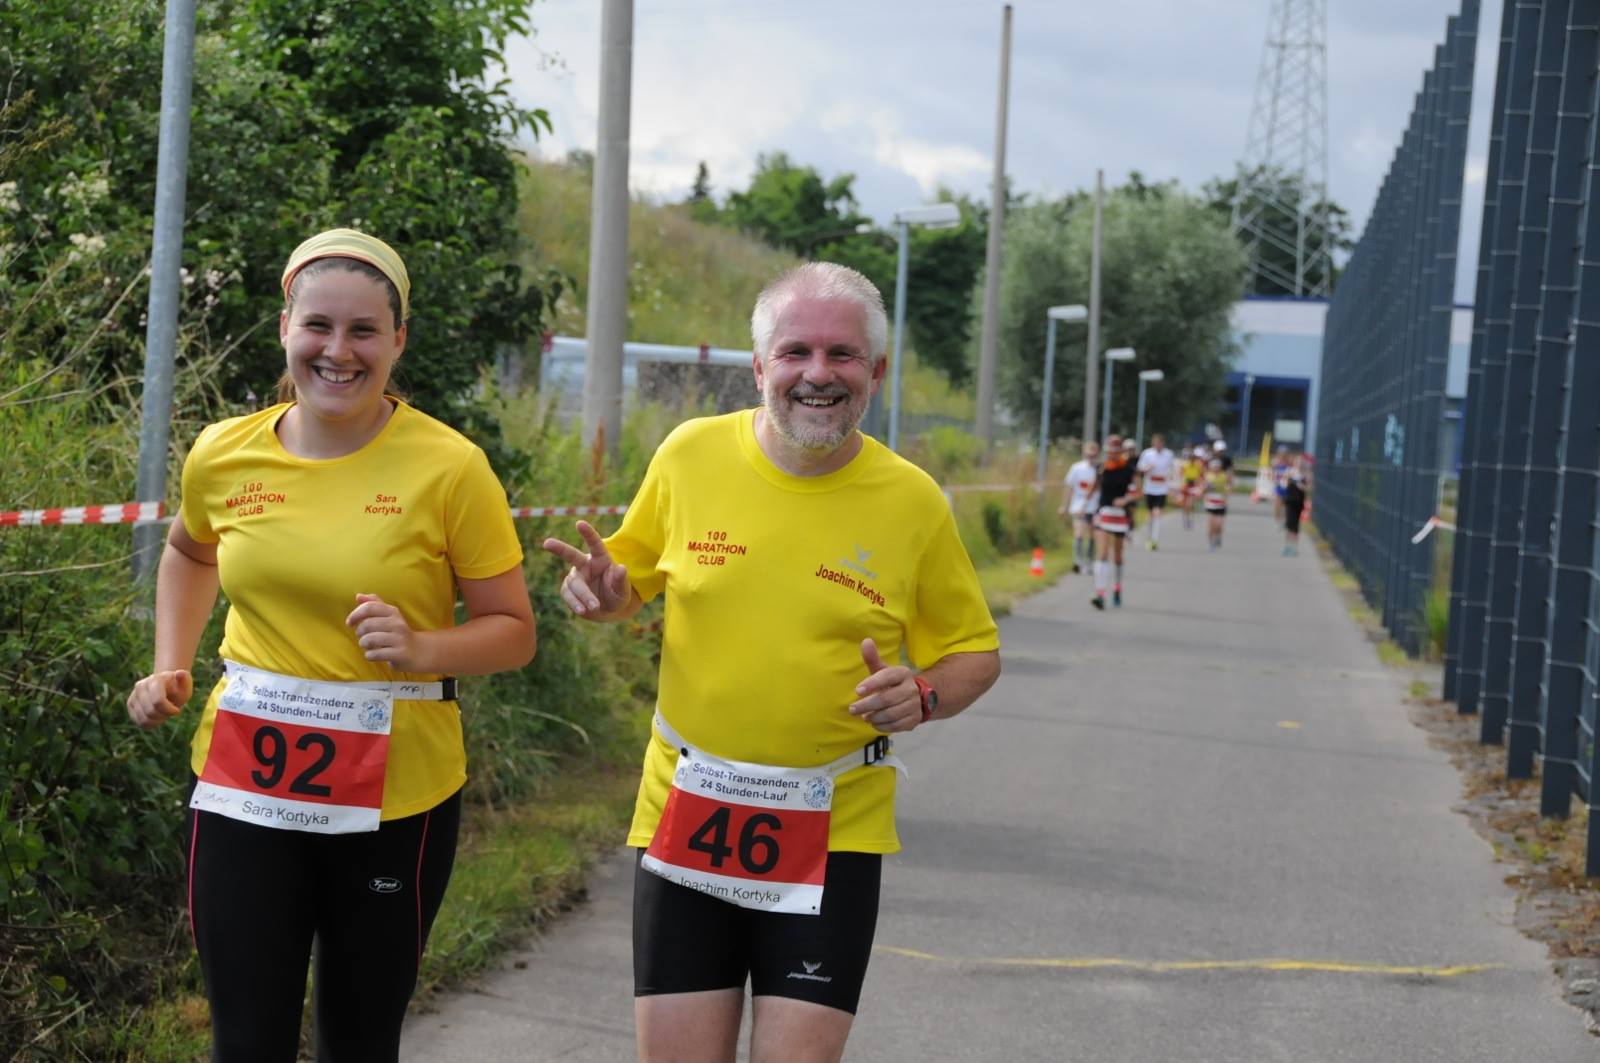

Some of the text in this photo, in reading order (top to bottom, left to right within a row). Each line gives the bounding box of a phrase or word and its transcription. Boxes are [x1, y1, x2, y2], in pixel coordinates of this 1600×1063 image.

[243, 482, 263, 494] 100
[226, 493, 286, 509] MARATHON
[375, 494, 397, 503] Sara
[237, 505, 264, 517] CLUB
[364, 504, 402, 515] Kortyka
[707, 531, 727, 542] 100
[687, 541, 747, 555] MARATHON
[697, 555, 725, 566] CLUB
[815, 564, 856, 590] Joachim
[856, 580, 885, 607] Kortyka
[252, 685, 355, 710] Selbst-Transzendenz
[256, 700, 268, 711] 24
[270, 703, 341, 722] Stunden-Lauf
[251, 725, 337, 798] 92
[692, 762, 800, 789] Selbst-Transzendenz
[700, 779, 712, 790] 24
[715, 783, 788, 801] Stunden-Lauf
[241, 801, 329, 827] Sara Kortyka
[687, 806, 783, 875] 46
[732, 885, 781, 904] Kortyka
